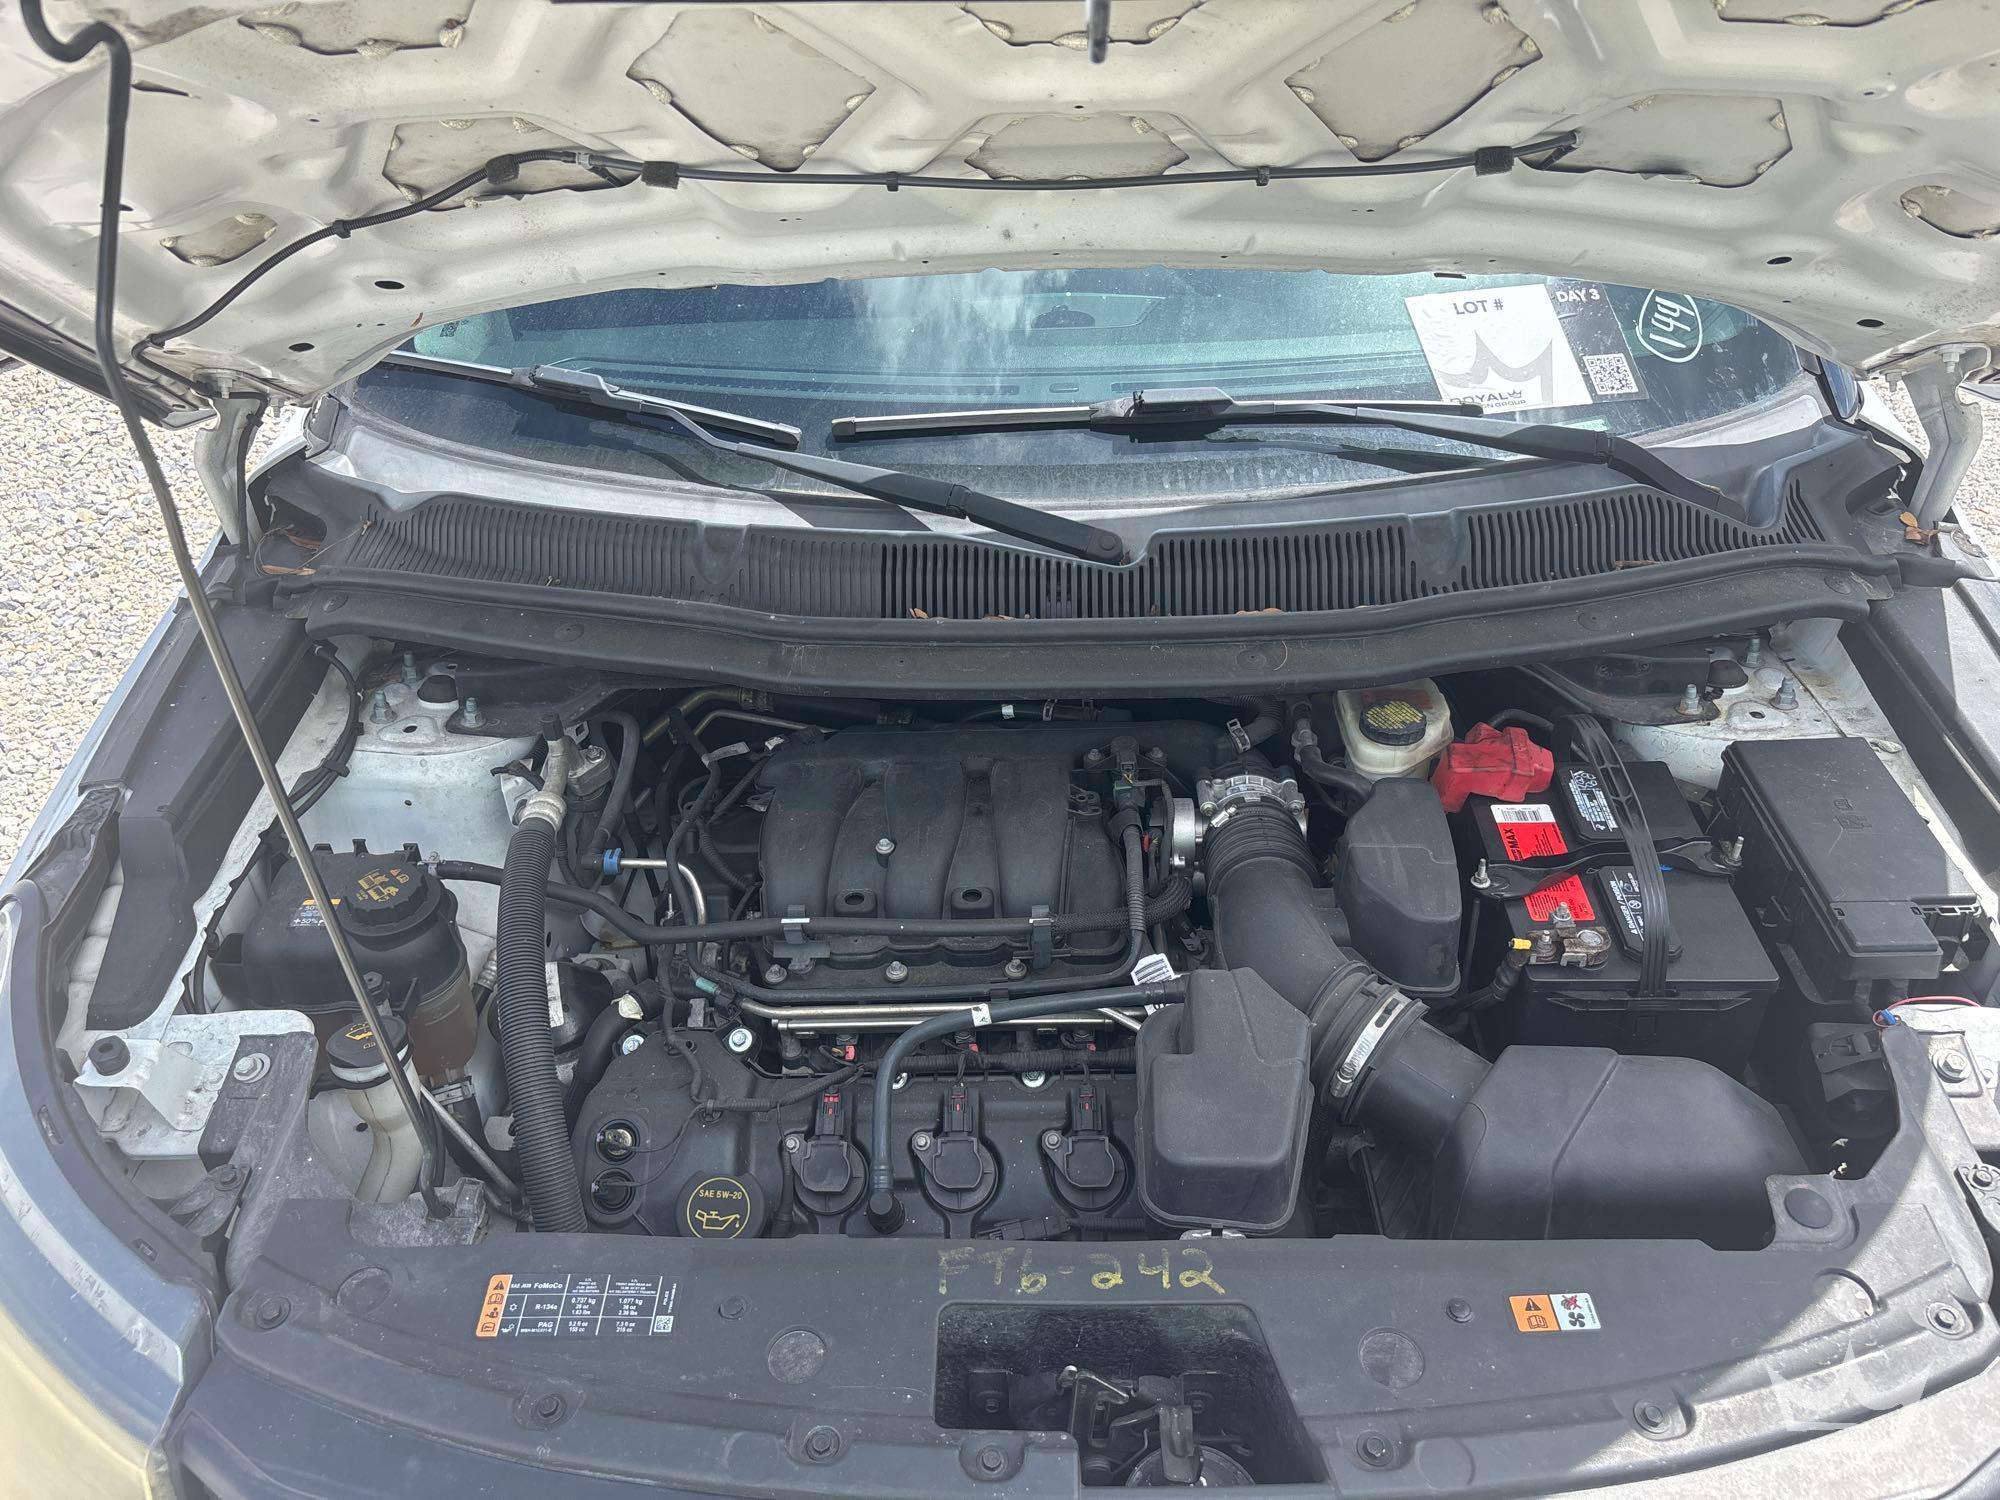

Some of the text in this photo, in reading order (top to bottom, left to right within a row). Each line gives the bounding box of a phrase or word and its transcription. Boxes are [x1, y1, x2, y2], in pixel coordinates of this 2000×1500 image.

[1556, 290, 1600, 304] DAY 3
[1452, 298, 1505, 315] LOT #
[1503, 828, 1520, 850] MAX
[1620, 905, 1636, 928] DANGER
[698, 1189, 743, 1200] SAE 5W-20
